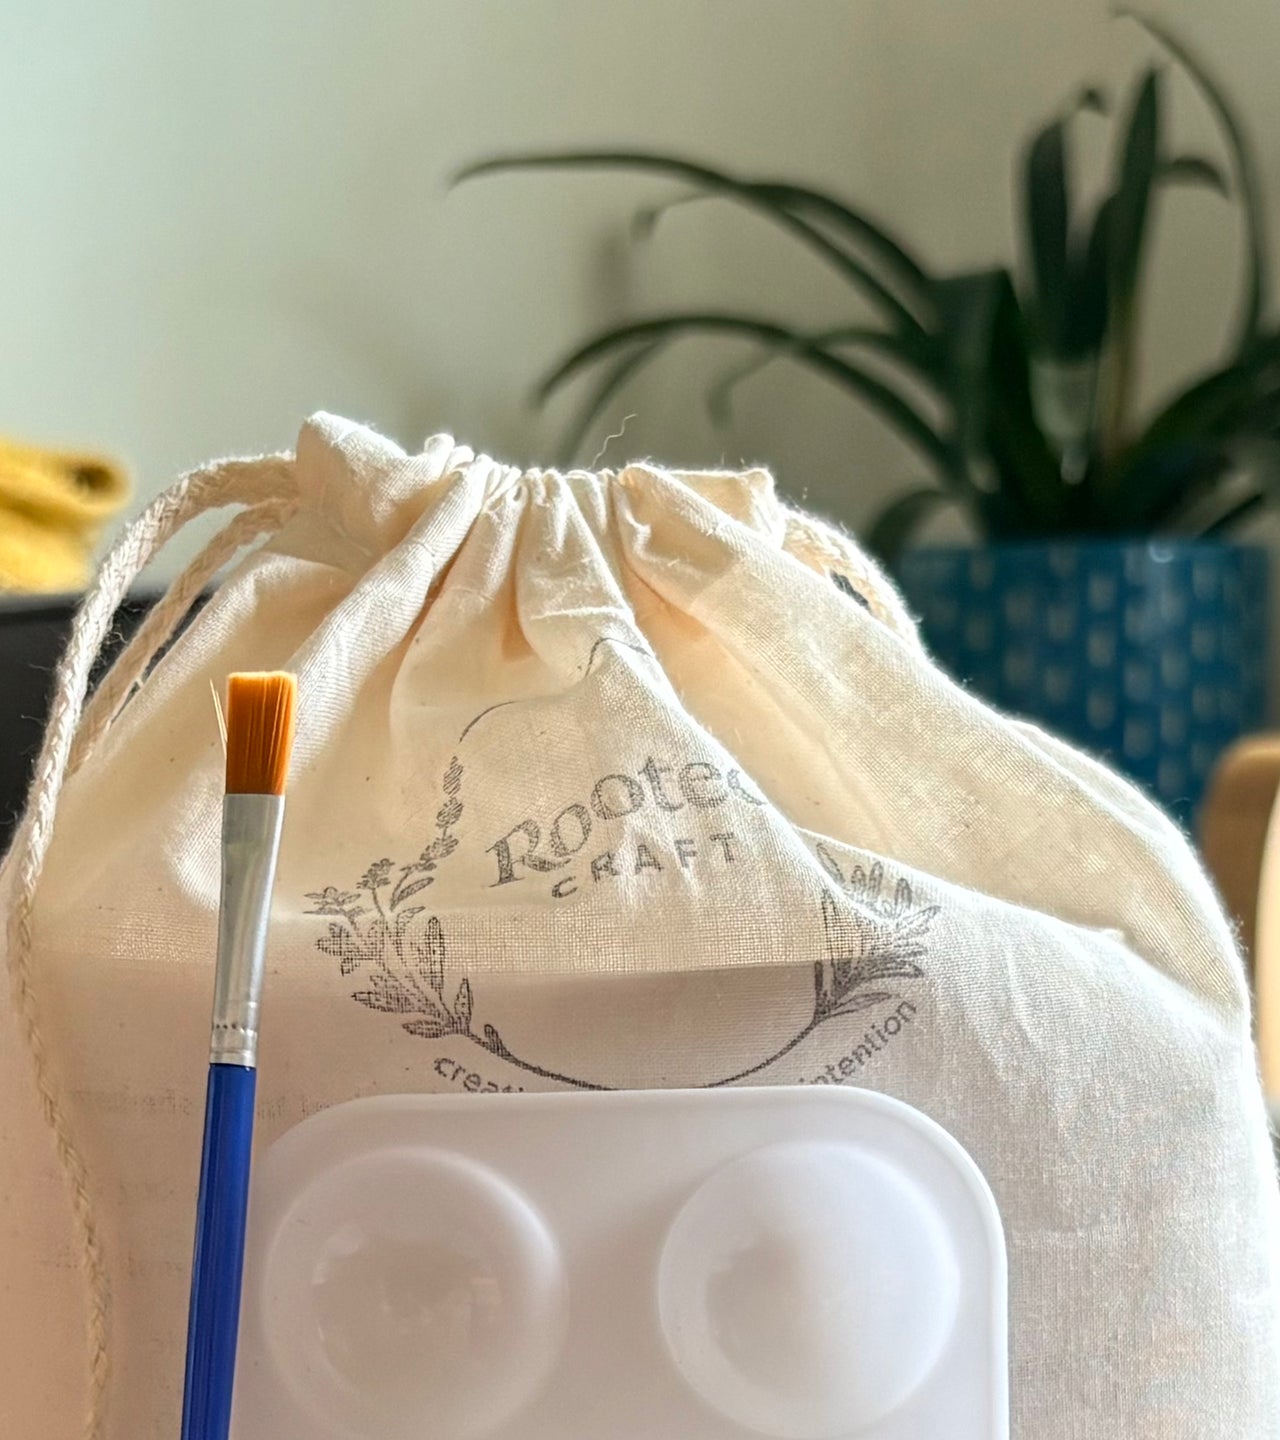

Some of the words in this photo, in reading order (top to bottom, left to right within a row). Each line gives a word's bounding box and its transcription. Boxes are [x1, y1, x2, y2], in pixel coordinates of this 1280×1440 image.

[552, 831, 735, 899] CRAFT
[433, 1057, 524, 1093] crea
[799, 1000, 917, 1084] tention
